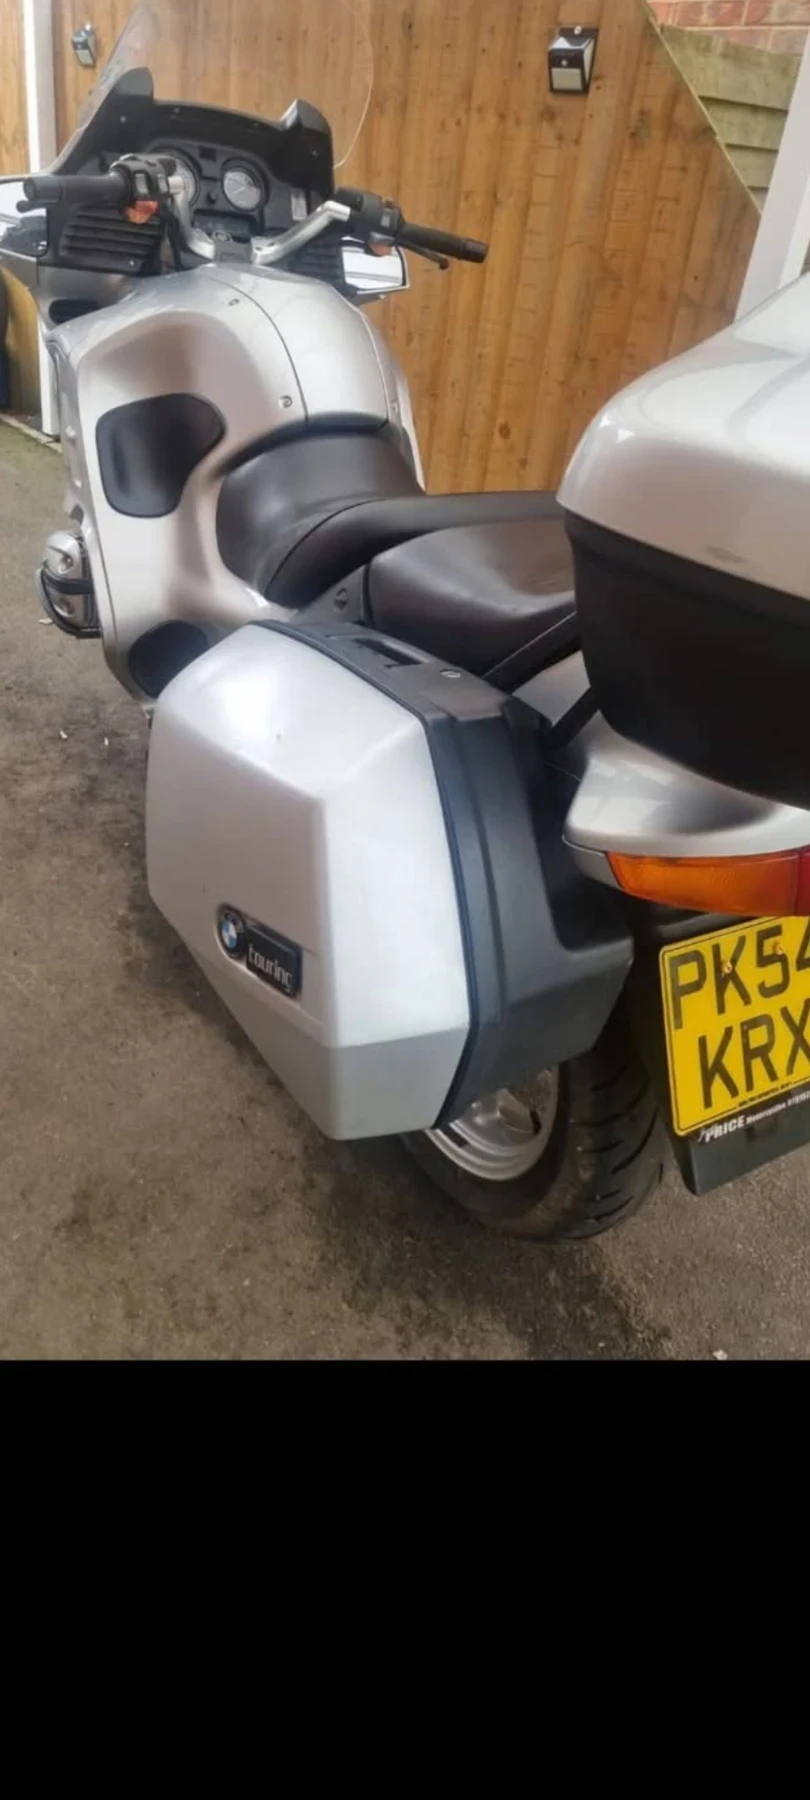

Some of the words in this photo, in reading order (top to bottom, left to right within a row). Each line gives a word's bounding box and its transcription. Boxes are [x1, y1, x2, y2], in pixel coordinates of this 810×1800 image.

[248, 943, 293, 993] touring
[698, 997, 810, 1110] KRX
[705, 1115, 745, 1143] PRICE
